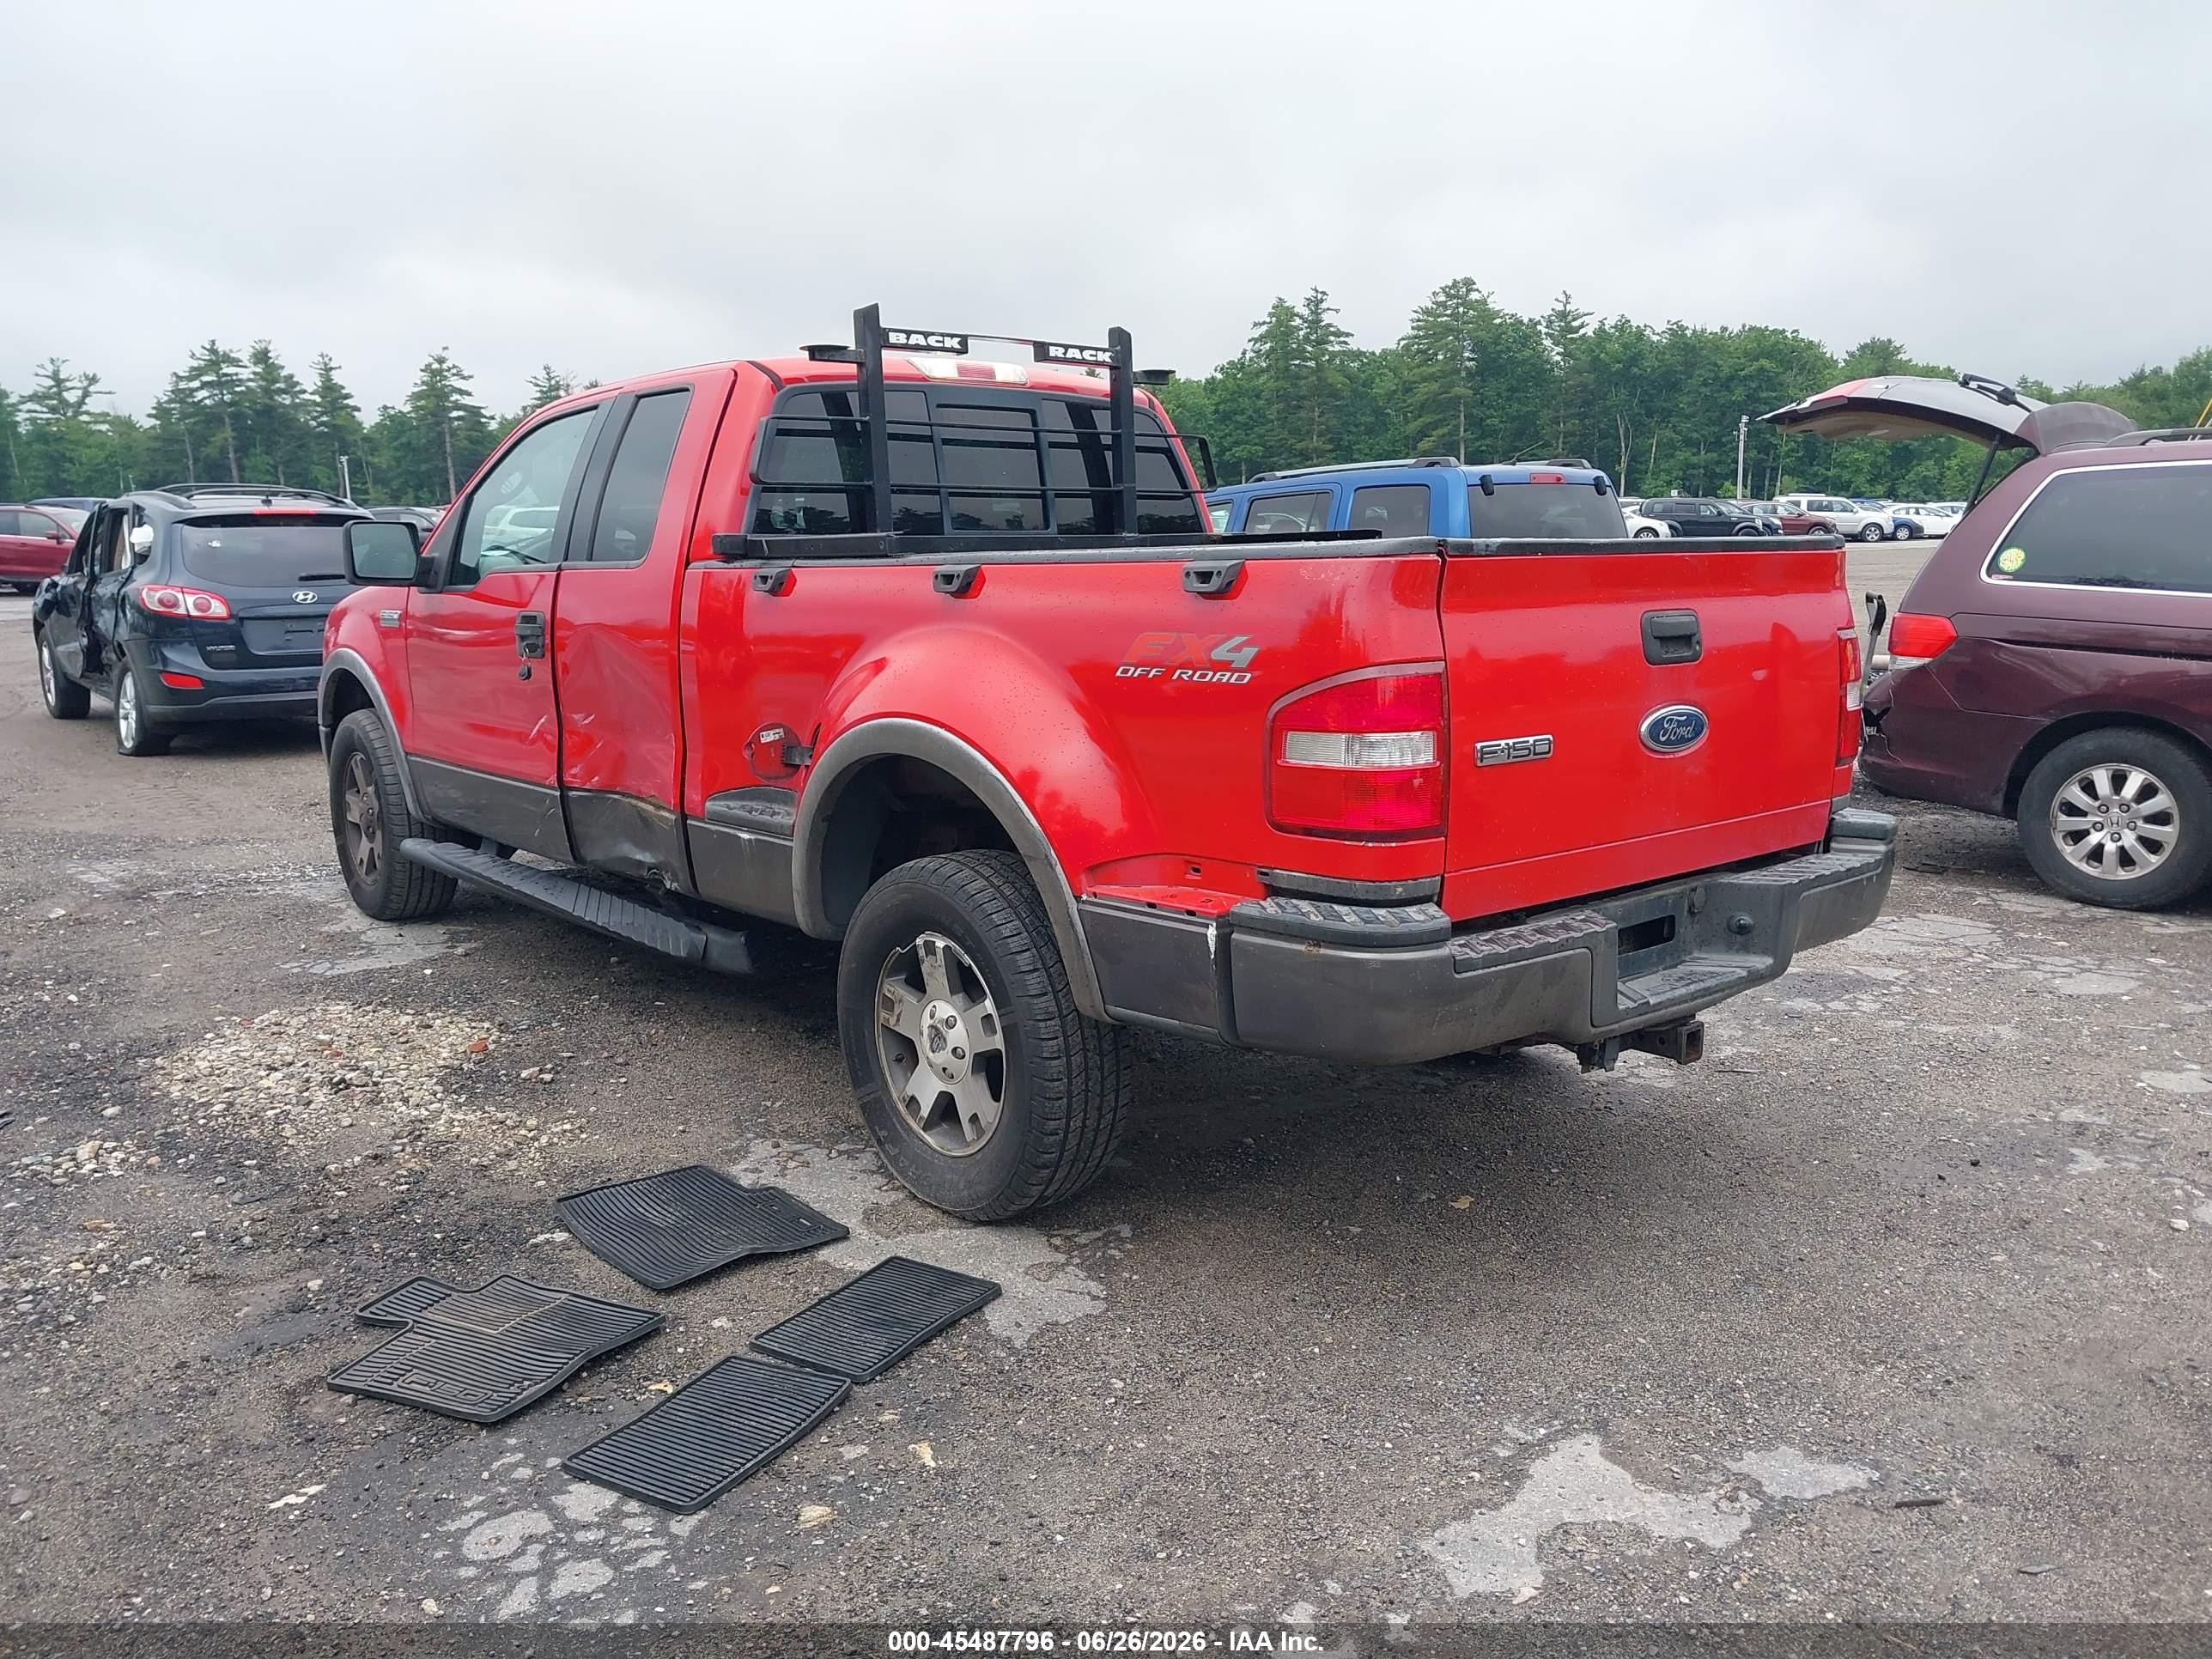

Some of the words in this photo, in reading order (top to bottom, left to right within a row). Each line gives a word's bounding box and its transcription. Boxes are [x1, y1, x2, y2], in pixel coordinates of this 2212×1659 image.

[888, 331, 963, 349] BACK
[1048, 345, 1114, 362] RACK
[1121, 632, 1260, 668] FX4
[1115, 665, 1166, 679] OFF
[1172, 669, 1253, 684] ROAD
[1659, 715, 1695, 742] Ford
